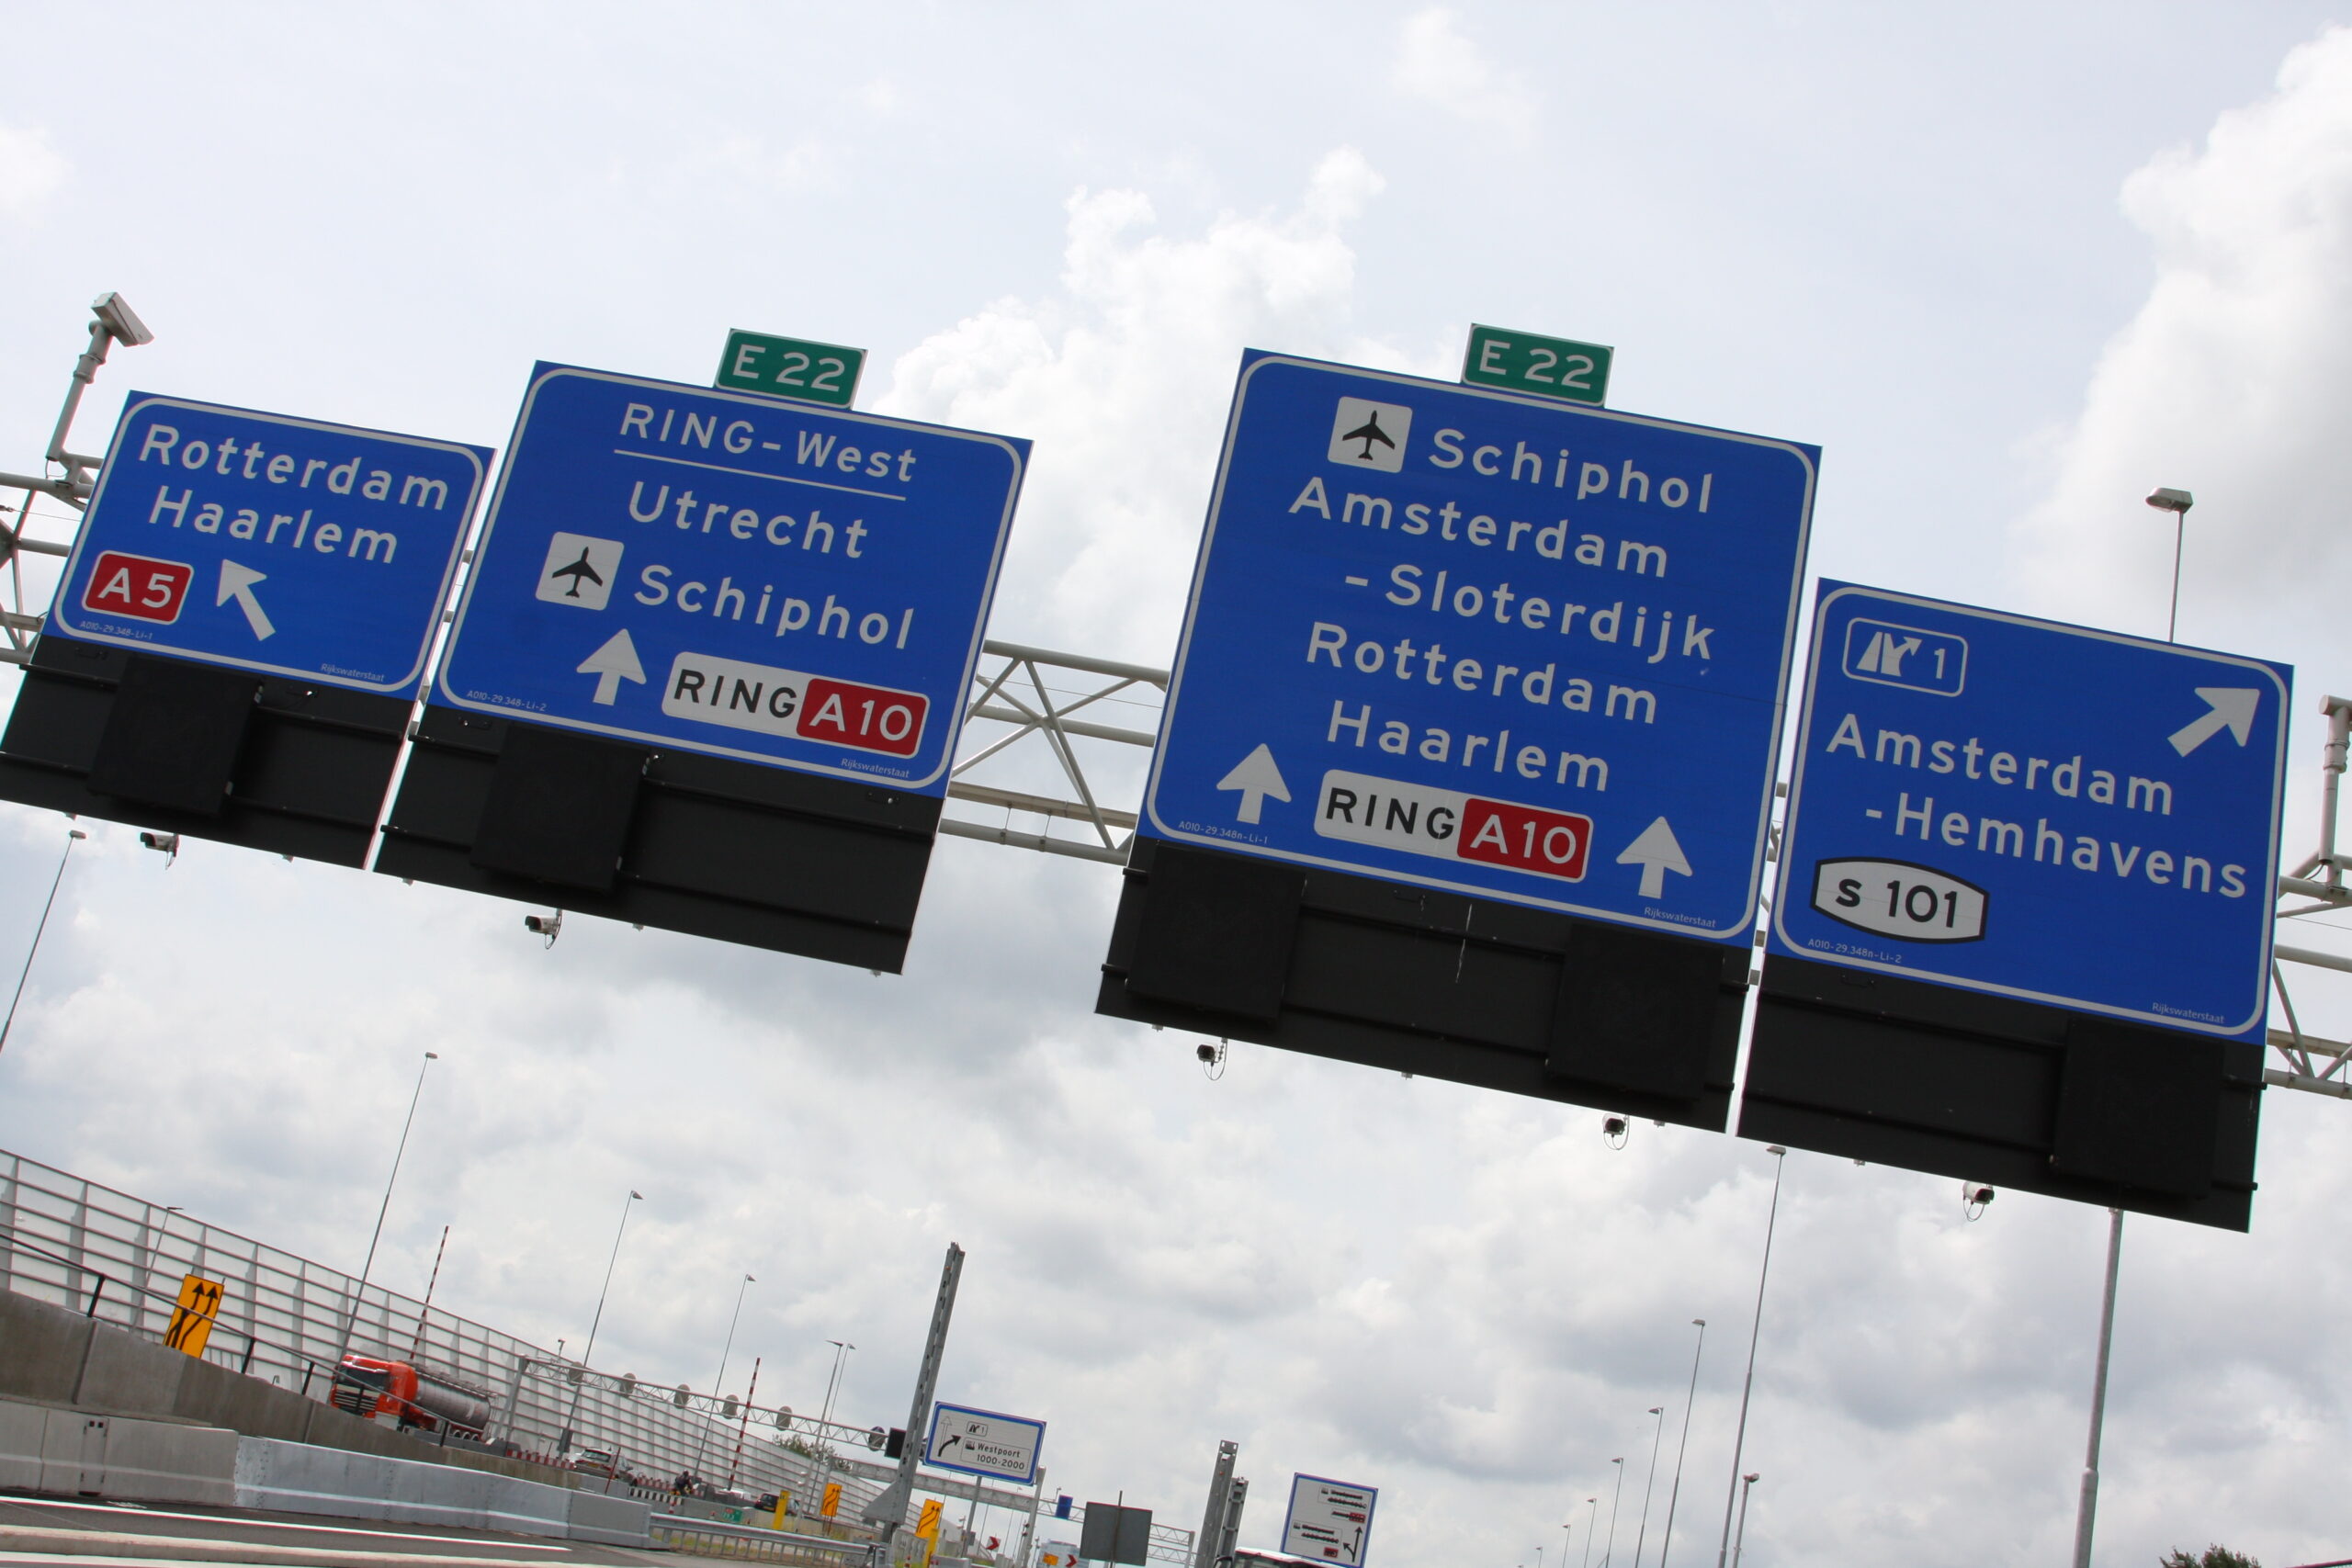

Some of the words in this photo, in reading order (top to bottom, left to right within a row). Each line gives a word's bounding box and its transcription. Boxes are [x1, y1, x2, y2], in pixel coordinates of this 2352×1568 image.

[733, 344, 765, 378] E
[776, 353, 844, 391] 22
[1479, 340, 1510, 375] E
[1523, 349, 1594, 389] 22
[140, 424, 447, 510] Rotterdam
[1430, 428, 1712, 513] Schiphol
[149, 485, 397, 563] Haarlem
[629, 481, 867, 558] Utrecht
[1289, 477, 1667, 577] Amsterdam
[97, 565, 175, 609] A5
[634, 565, 913, 649] Schiphol
[321, 662, 384, 682] Rijkswaterstaat
[1307, 622, 1657, 723] Rotterdam
[1934, 648, 1946, 680] 1
[674, 669, 797, 717] RING
[809, 694, 912, 740] A10
[841, 758, 910, 778] Rijkswaterstaat
[1328, 700, 1608, 791] Haarlem
[1826, 714, 2172, 815] Amsterdam
[1327, 787, 1454, 840] RING
[1470, 815, 1576, 863] A10
[1644, 906, 1716, 928] Rijkswaterstaat
[1887, 881, 1957, 928] 101
[2152, 1002, 2224, 1024] Rijkswaterstaat
[977, 1453, 1024, 1470] 1000-2000
[978, 1442, 1020, 1459] Westpoort
